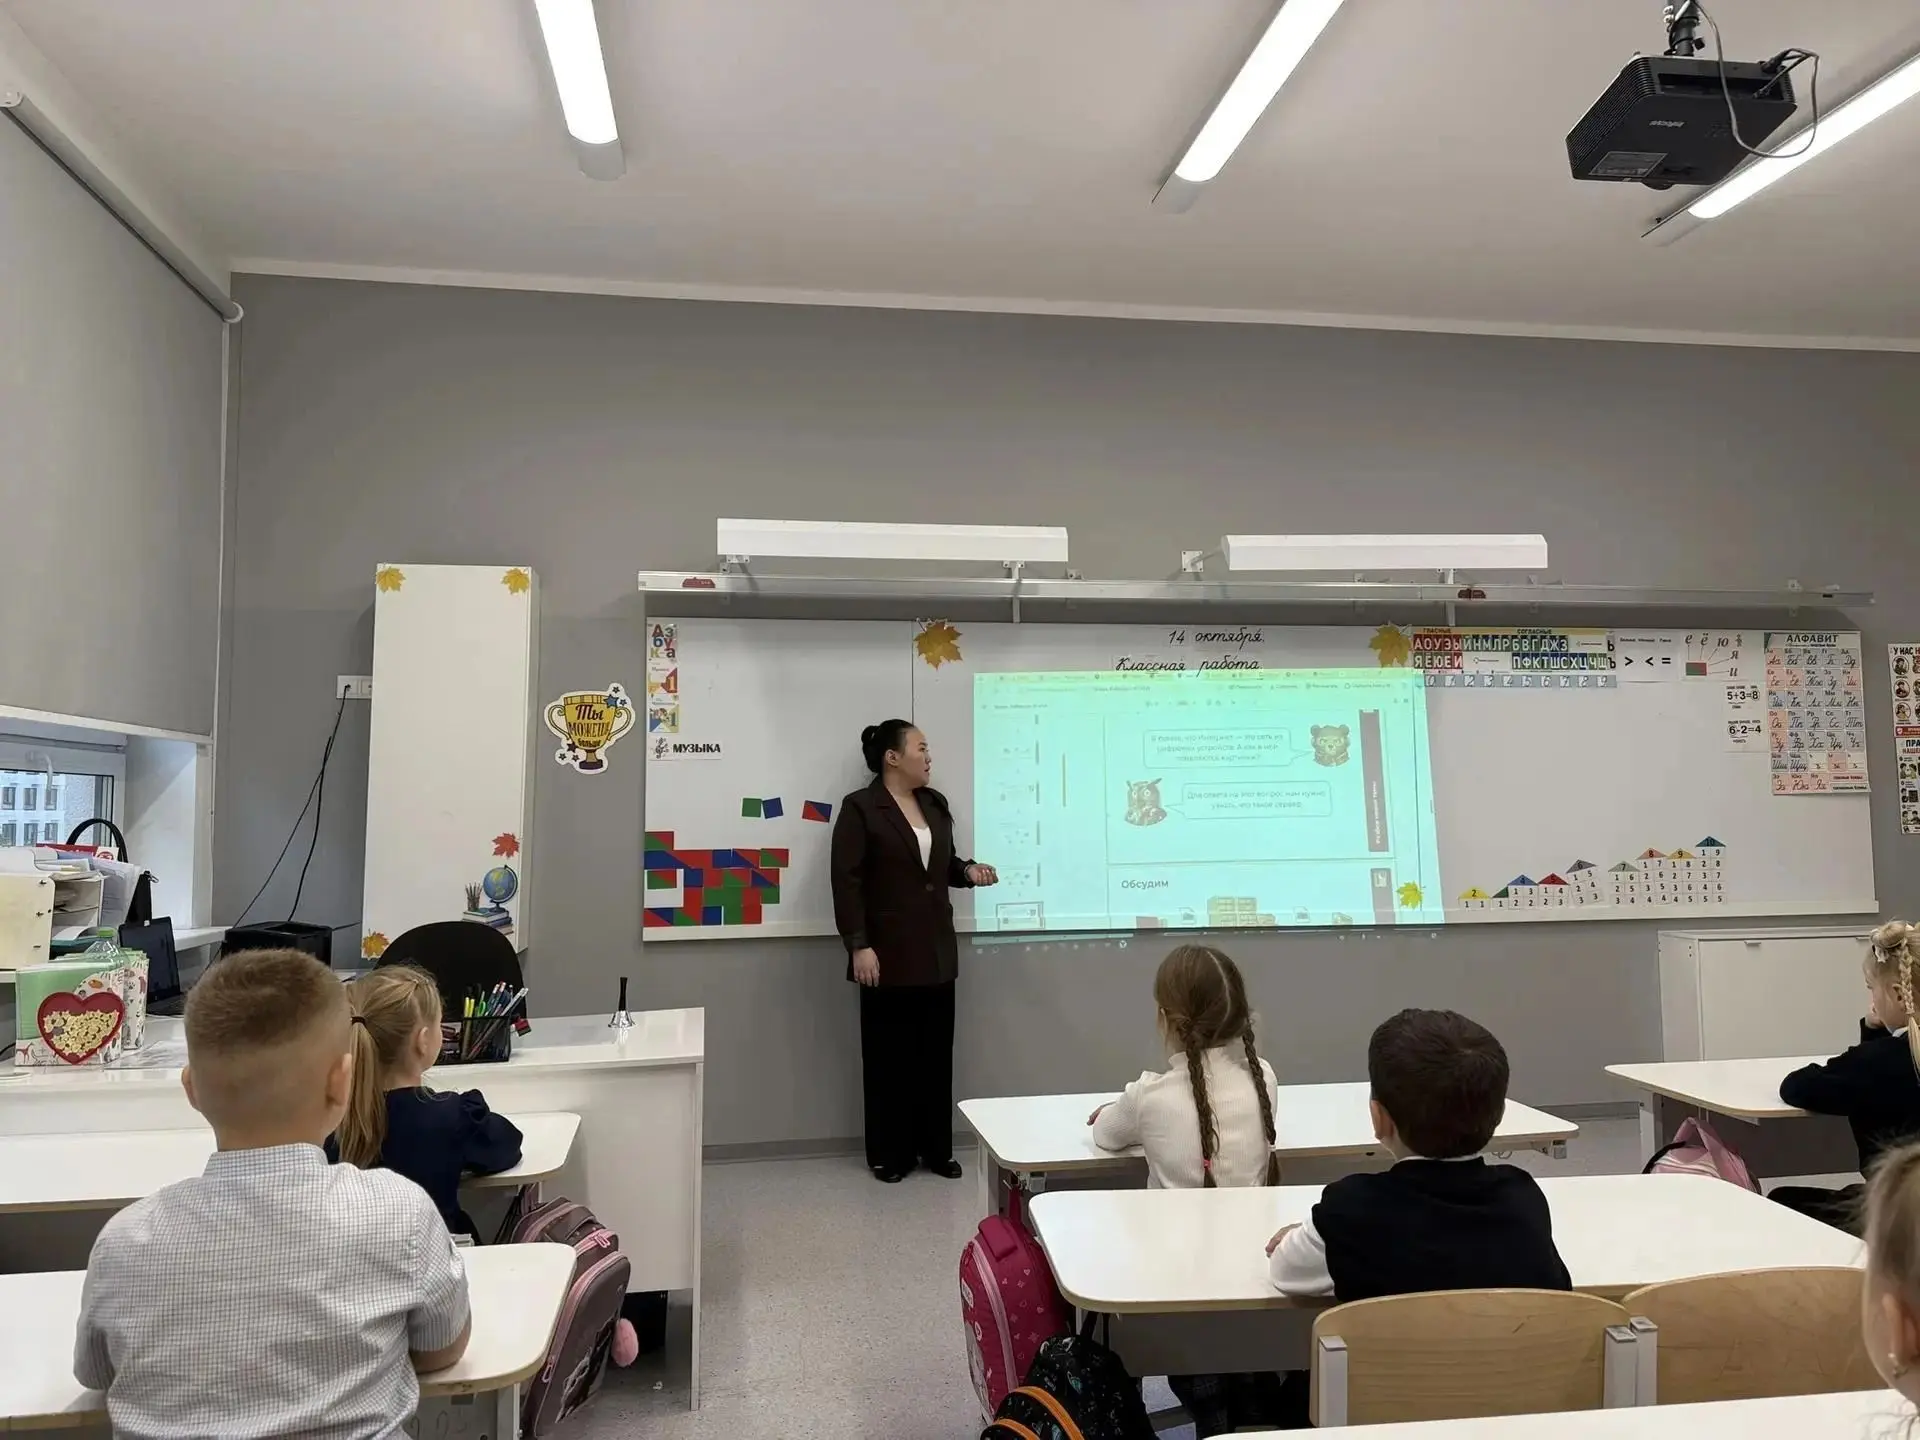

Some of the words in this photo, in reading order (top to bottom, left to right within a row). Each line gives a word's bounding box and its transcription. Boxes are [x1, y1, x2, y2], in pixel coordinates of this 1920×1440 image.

[1169, 630, 1185, 644] 14
[1685, 635, 1693, 645] е
[1700, 633, 1708, 646] ё
[1786, 634, 1839, 643] АЛФАВИТ
[1894, 647, 1899, 655] У
[1900, 647, 1913, 655] НАС
[1727, 691, 1758, 700] 5+3=8
[576, 704, 604, 720] Ты
[1729, 725, 1761, 734] 6-2=4
[673, 743, 721, 753] МУЗЫКА
[1121, 879, 1169, 890] Обсудим
